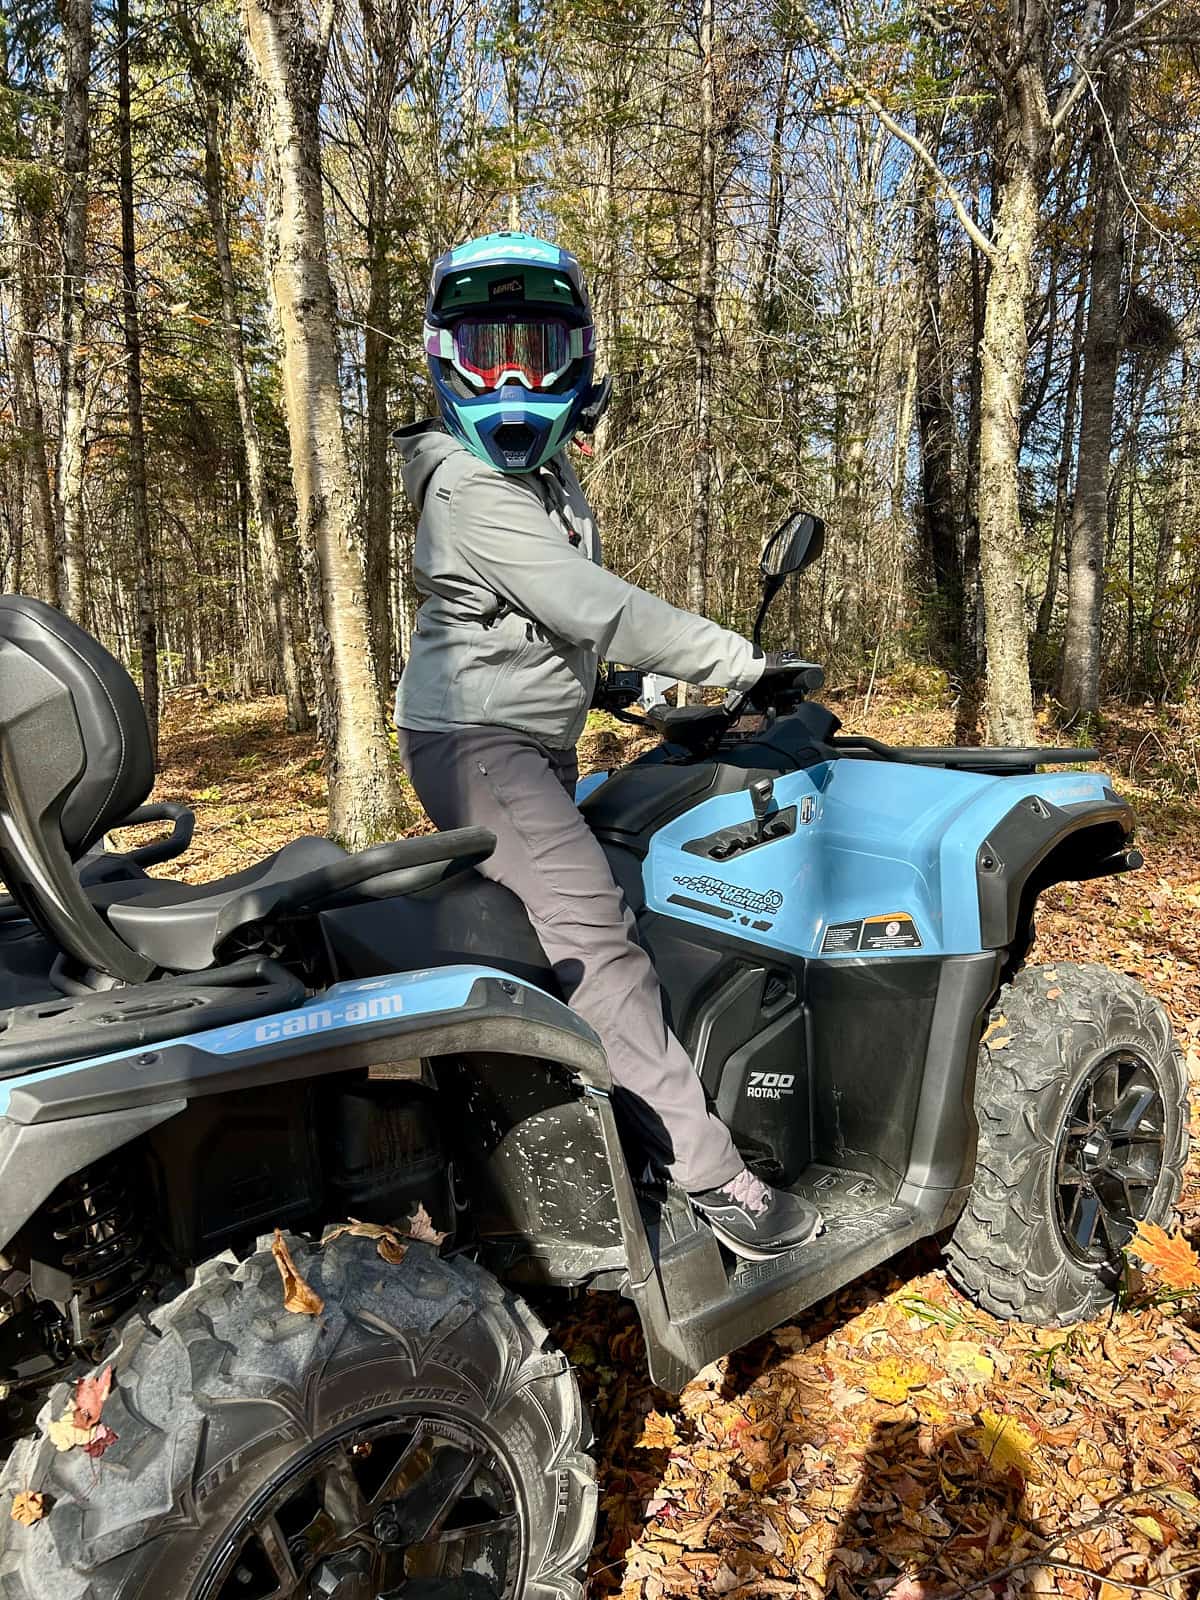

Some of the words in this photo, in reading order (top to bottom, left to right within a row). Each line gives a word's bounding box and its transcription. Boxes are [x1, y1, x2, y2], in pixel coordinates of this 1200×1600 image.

[704, 877, 764, 904] Mercier
[720, 891, 770, 911] Marine
[255, 994, 403, 1043] can-am
[748, 1071, 795, 1088] 700
[747, 1086, 781, 1099] ROTAX
[329, 1391, 393, 1425] TRAIL
[398, 1385, 471, 1406] FORCE
